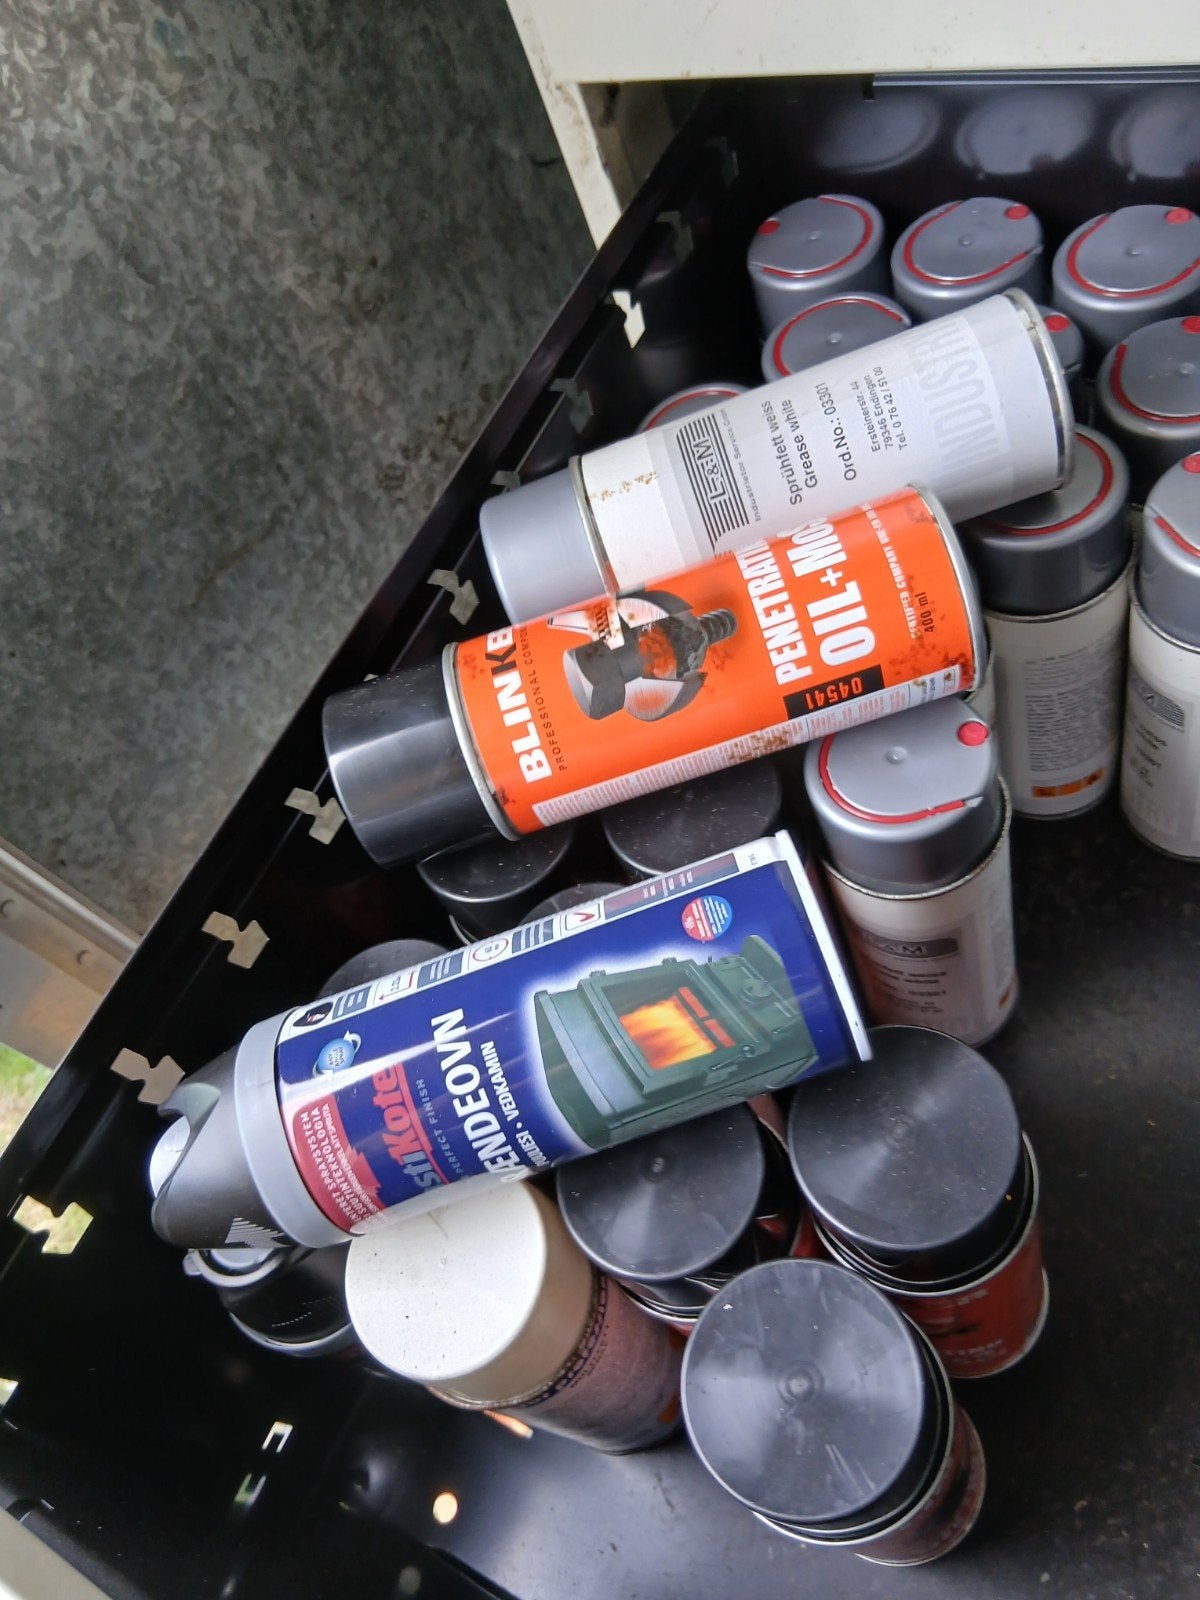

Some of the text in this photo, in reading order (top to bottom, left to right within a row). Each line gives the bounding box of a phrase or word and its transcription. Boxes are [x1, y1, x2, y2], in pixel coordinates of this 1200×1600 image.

[863, 373, 894, 450] 79346 Endingen
[878, 376, 889, 388] 51
[882, 392, 894, 406] 42
[887, 406, 899, 421] 76
[727, 428, 741, 460] Service
[761, 399, 803, 506] Sprühfett weiss
[781, 399, 818, 488] Grease white
[814, 381, 857, 481] Ord.No.: 03301
[895, 429, 908, 450] Tel.
[914, 591, 935, 633] 400 ml
[527, 670, 568, 772] PROFESSIONAL
[805, 676, 864, 711] 04541
[480, 1041, 520, 1122] VEDKAMIN
[300, 1110, 337, 1190] SPRAYSYSTEM
[416, 1078, 464, 1173] PERFECT FINISH
